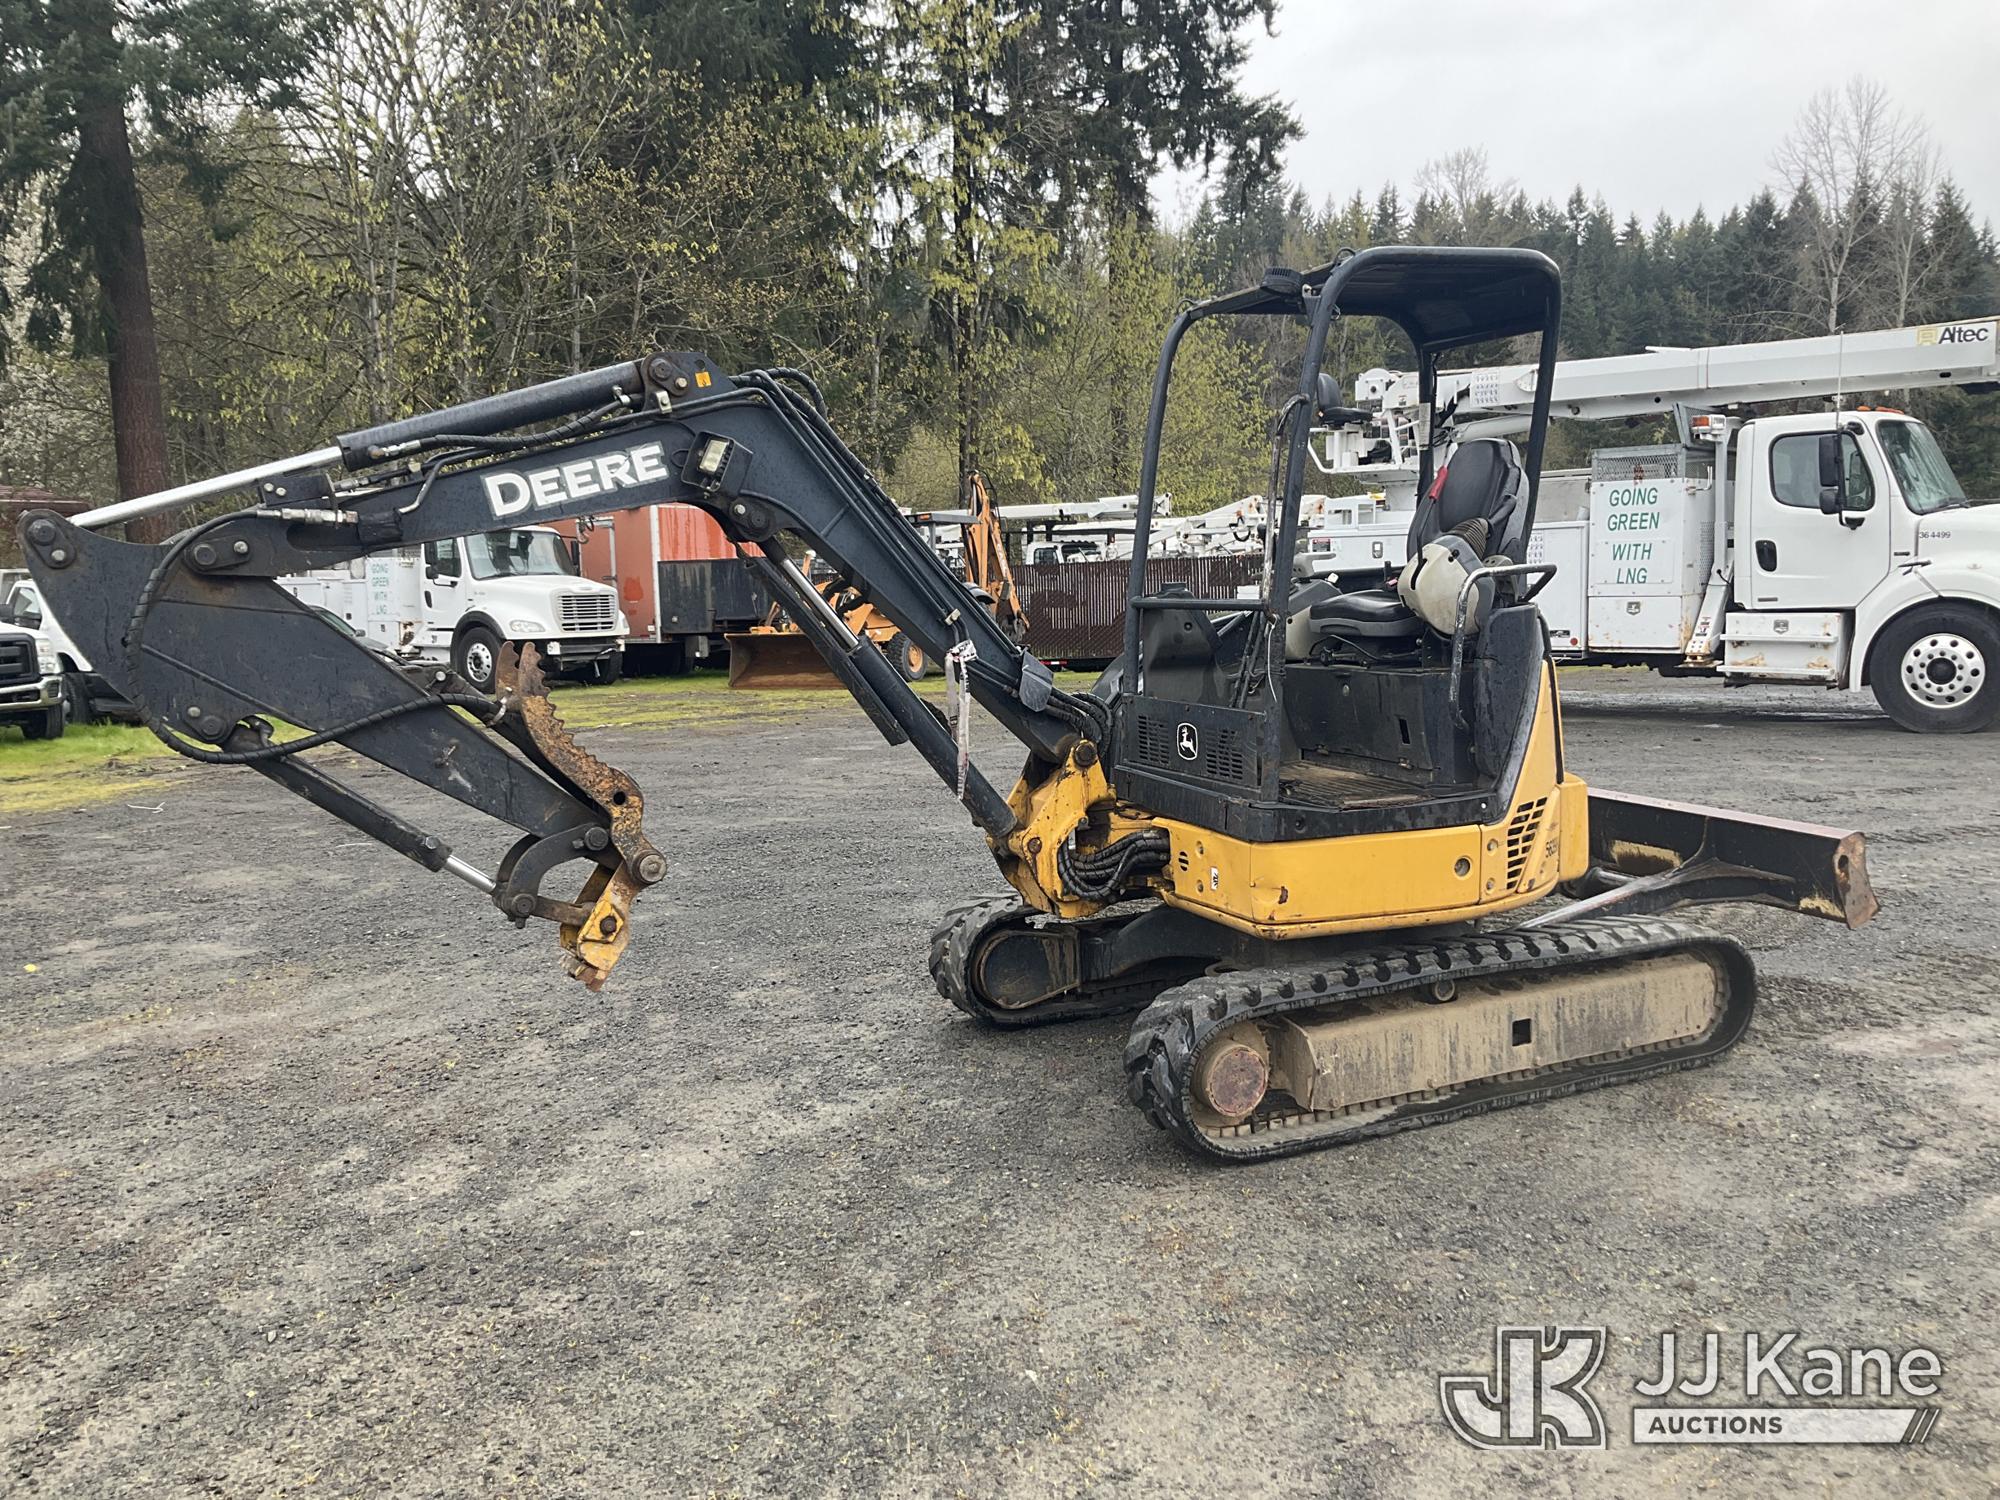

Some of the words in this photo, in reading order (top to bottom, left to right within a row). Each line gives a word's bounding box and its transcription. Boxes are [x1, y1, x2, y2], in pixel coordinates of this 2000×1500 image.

[1938, 326, 1989, 344] Altec
[484, 445, 668, 517] DEERE
[1609, 487, 1658, 507] GOING
[1607, 512, 1660, 531] GREEN
[1612, 543, 1653, 561] WITH
[1616, 567, 1648, 584] LNG
